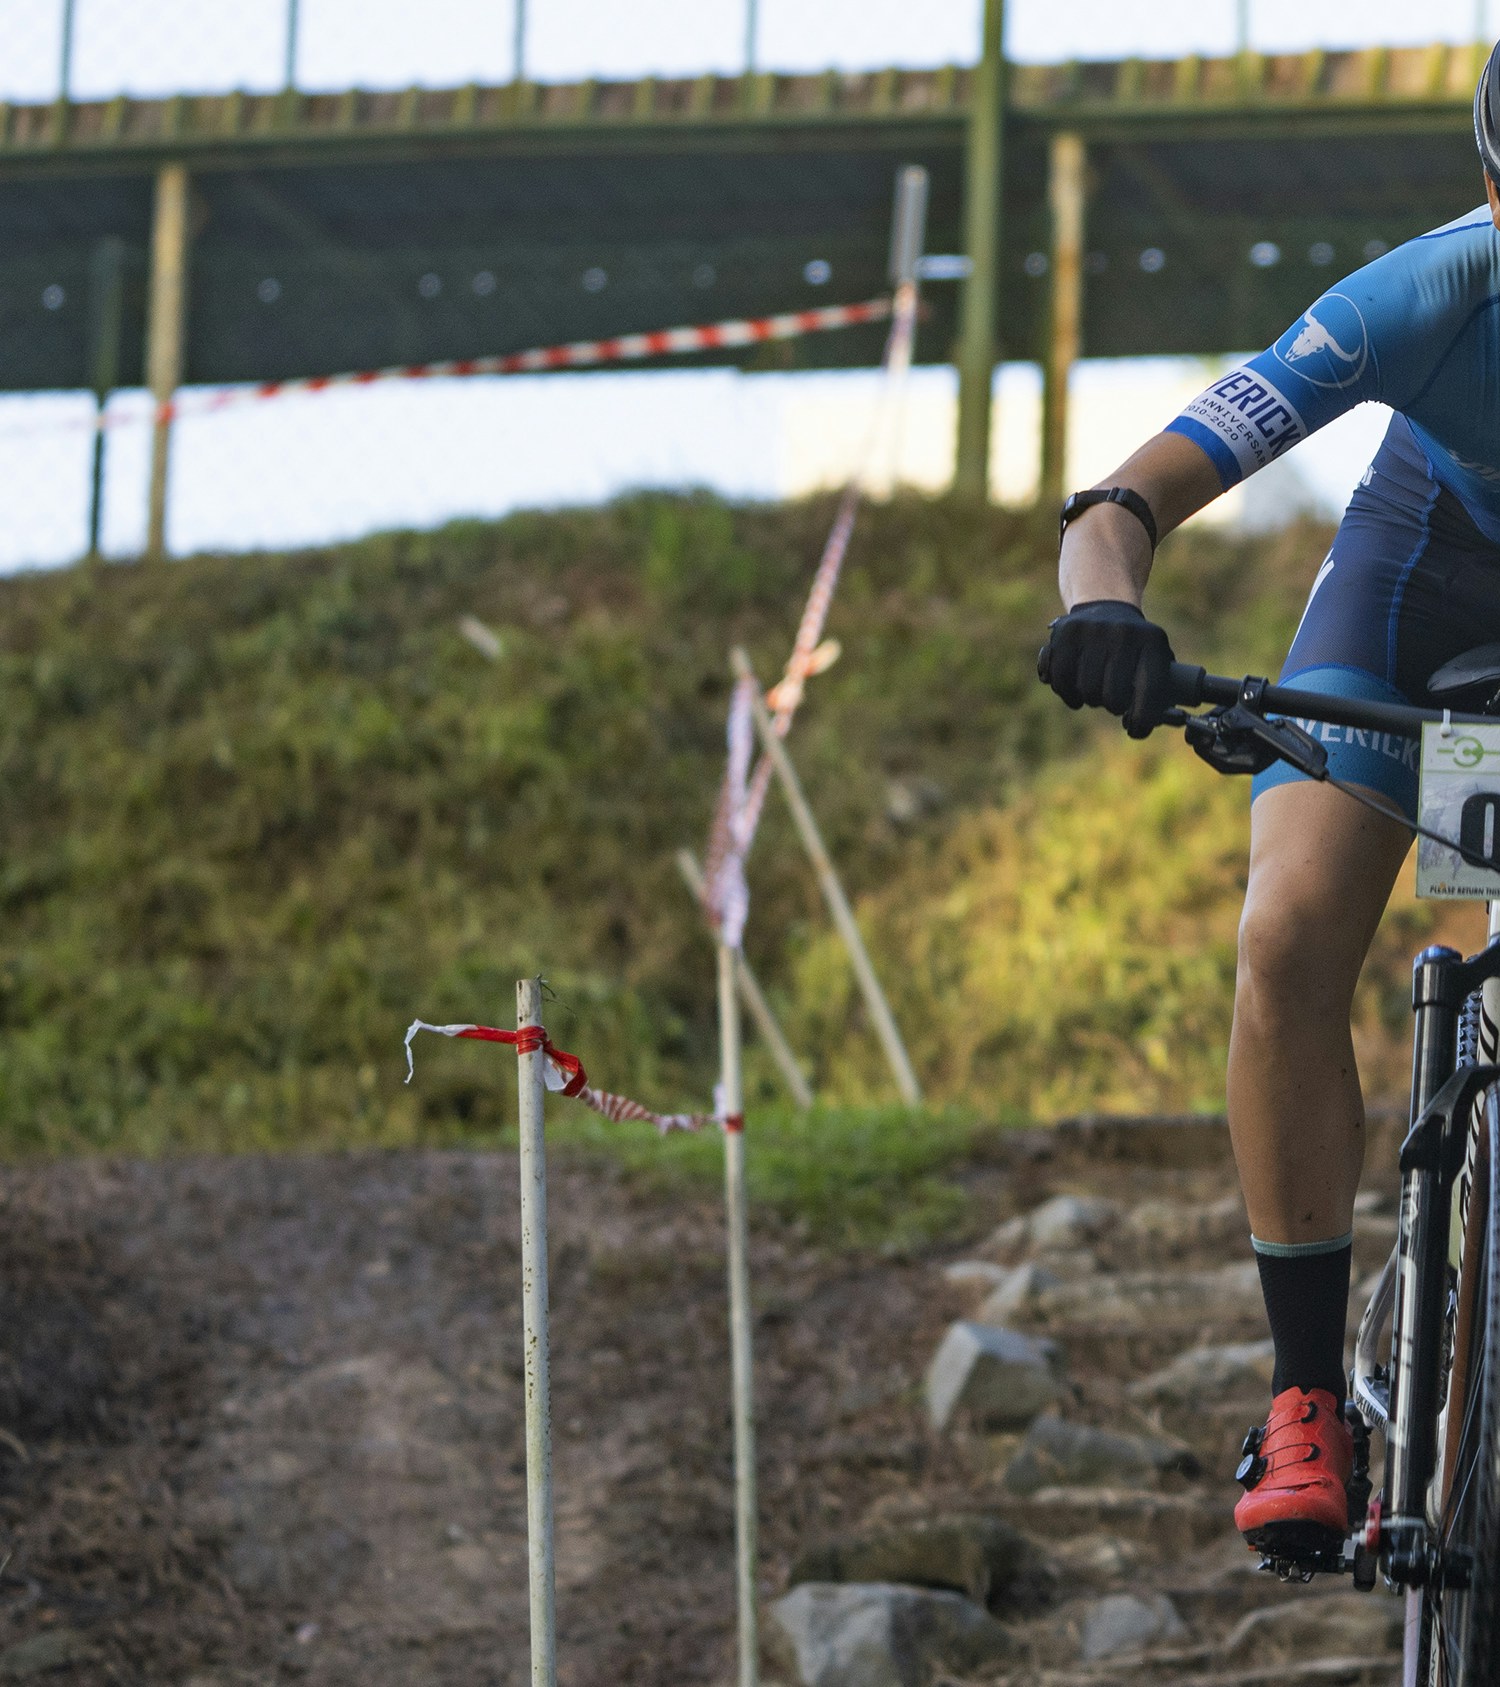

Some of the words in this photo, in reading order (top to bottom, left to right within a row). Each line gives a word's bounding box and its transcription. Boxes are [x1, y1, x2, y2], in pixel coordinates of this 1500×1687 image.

[1185, 404, 1239, 441] 010-2020
[1200, 398, 1266, 466] ANNIVERSAR
[1205, 371, 1301, 456] VERICK
[1294, 716, 1420, 772] VERICK
[1430, 884, 1456, 895] PLEASE
[1457, 886, 1484, 896] RETURN
[1485, 887, 1500, 896] THIS
